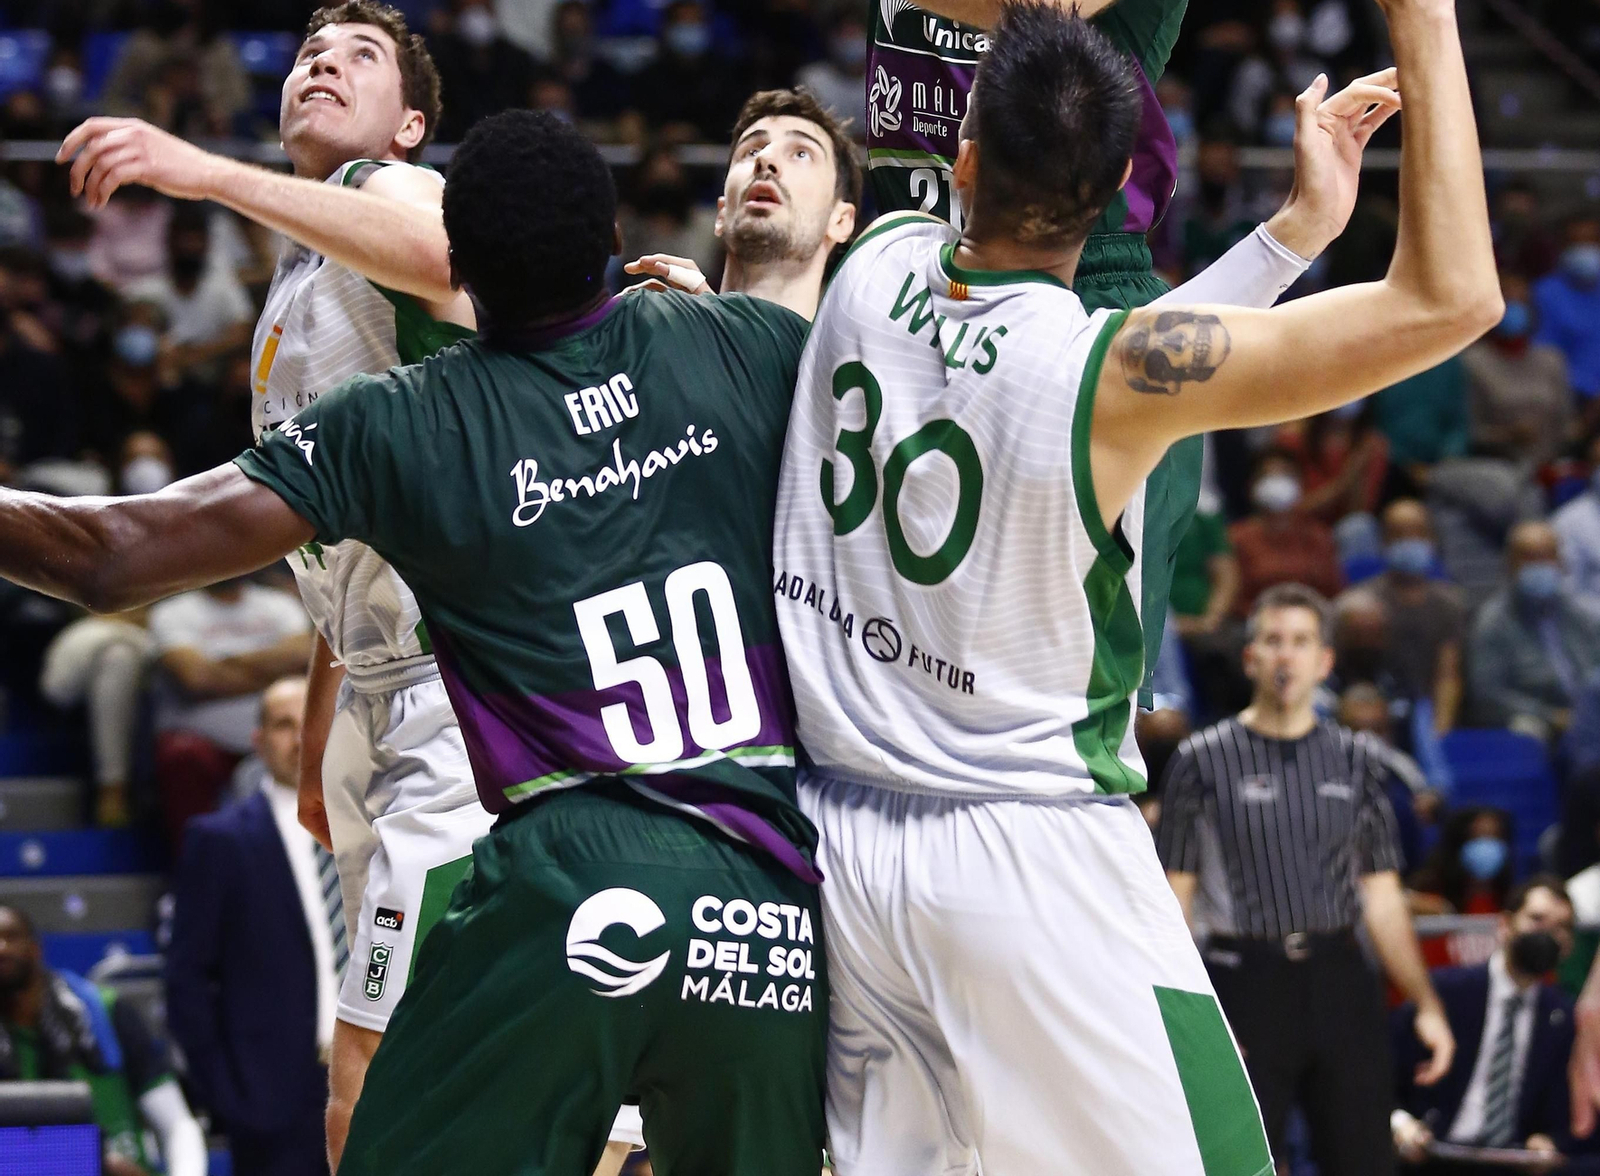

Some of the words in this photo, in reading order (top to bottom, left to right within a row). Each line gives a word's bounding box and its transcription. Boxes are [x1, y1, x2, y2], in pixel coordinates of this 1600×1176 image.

[912, 78, 972, 116] MÁL
[912, 116, 948, 138] Deporte
[563, 372, 640, 436] ERIC
[820, 360, 984, 587] 30
[772, 570, 854, 639] ADALOA
[907, 644, 976, 695] FUTUR
[572, 560, 762, 764] 50
[376, 915, 398, 928] acb
[691, 895, 814, 945] COSTA
[687, 938, 759, 974] DEL
[766, 946, 815, 980] SOL
[680, 971, 813, 1012] MÁLAGA
